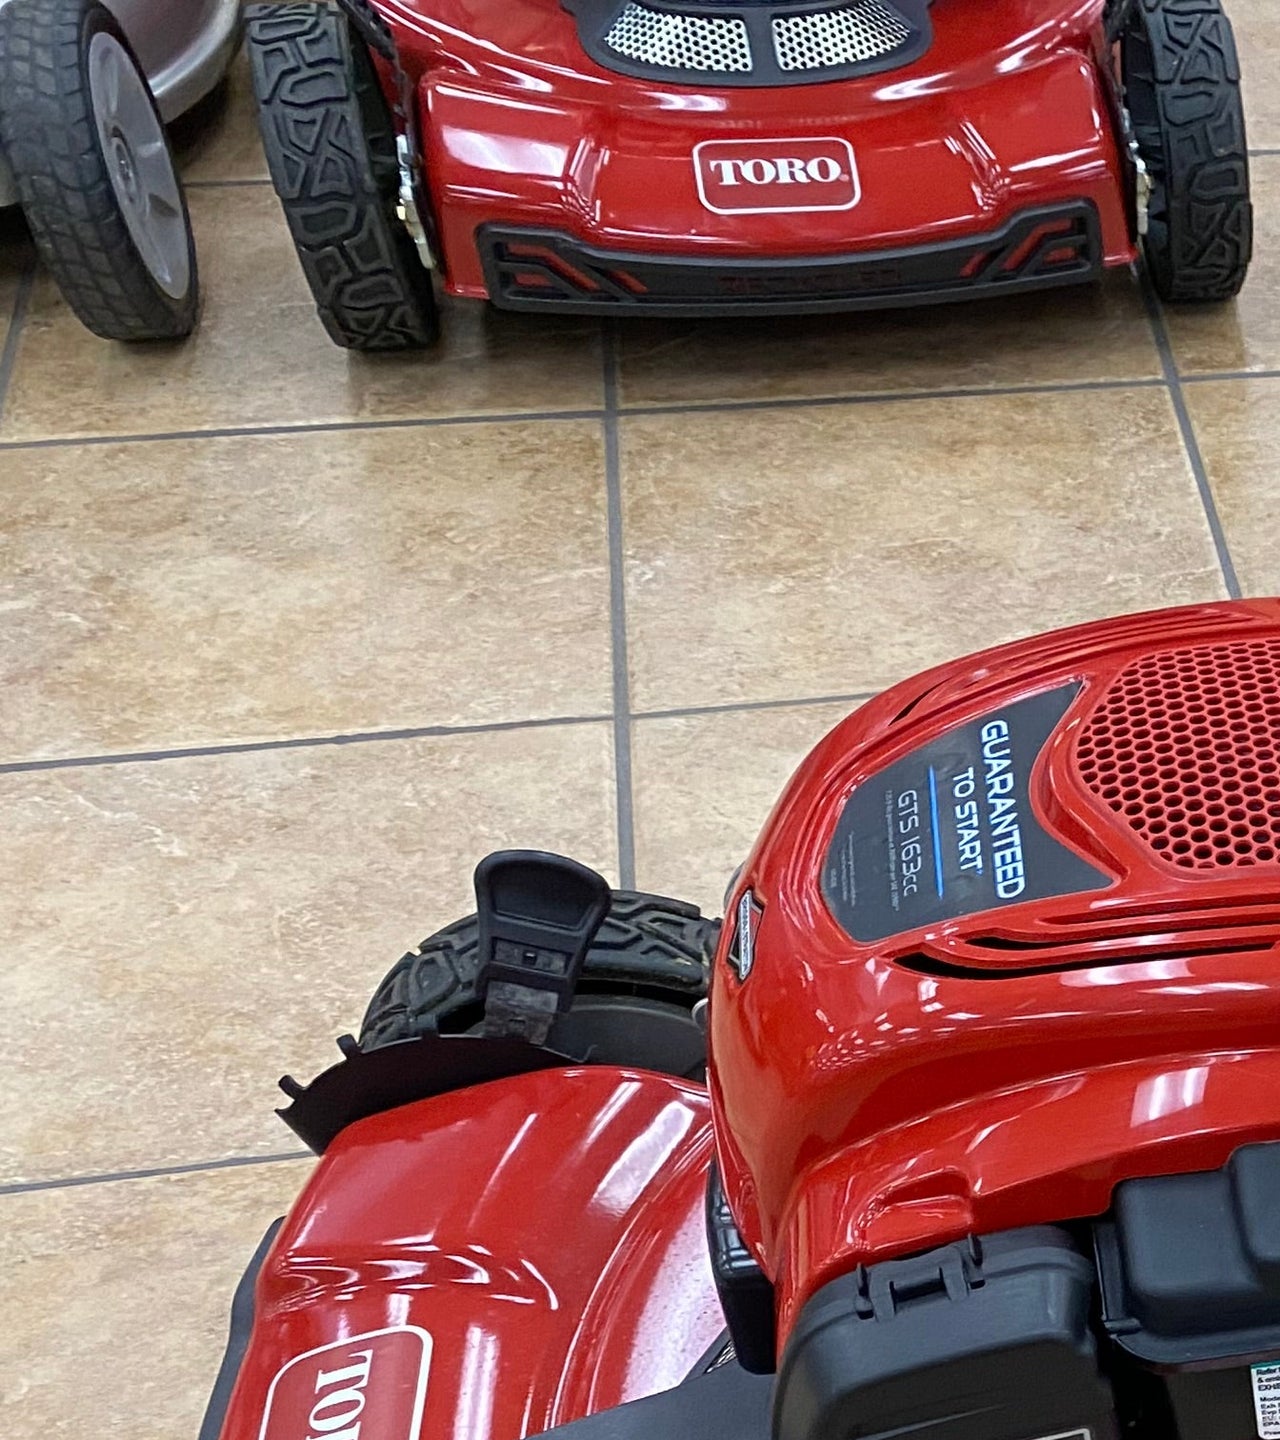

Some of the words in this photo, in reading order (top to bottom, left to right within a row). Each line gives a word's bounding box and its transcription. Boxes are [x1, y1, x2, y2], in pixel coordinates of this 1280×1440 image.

[709, 156, 841, 186] TORO
[951, 766, 976, 799] TO
[897, 788, 919, 835] GTS
[981, 719, 1026, 899] GUARANTEED
[899, 836, 921, 897] 163cc
